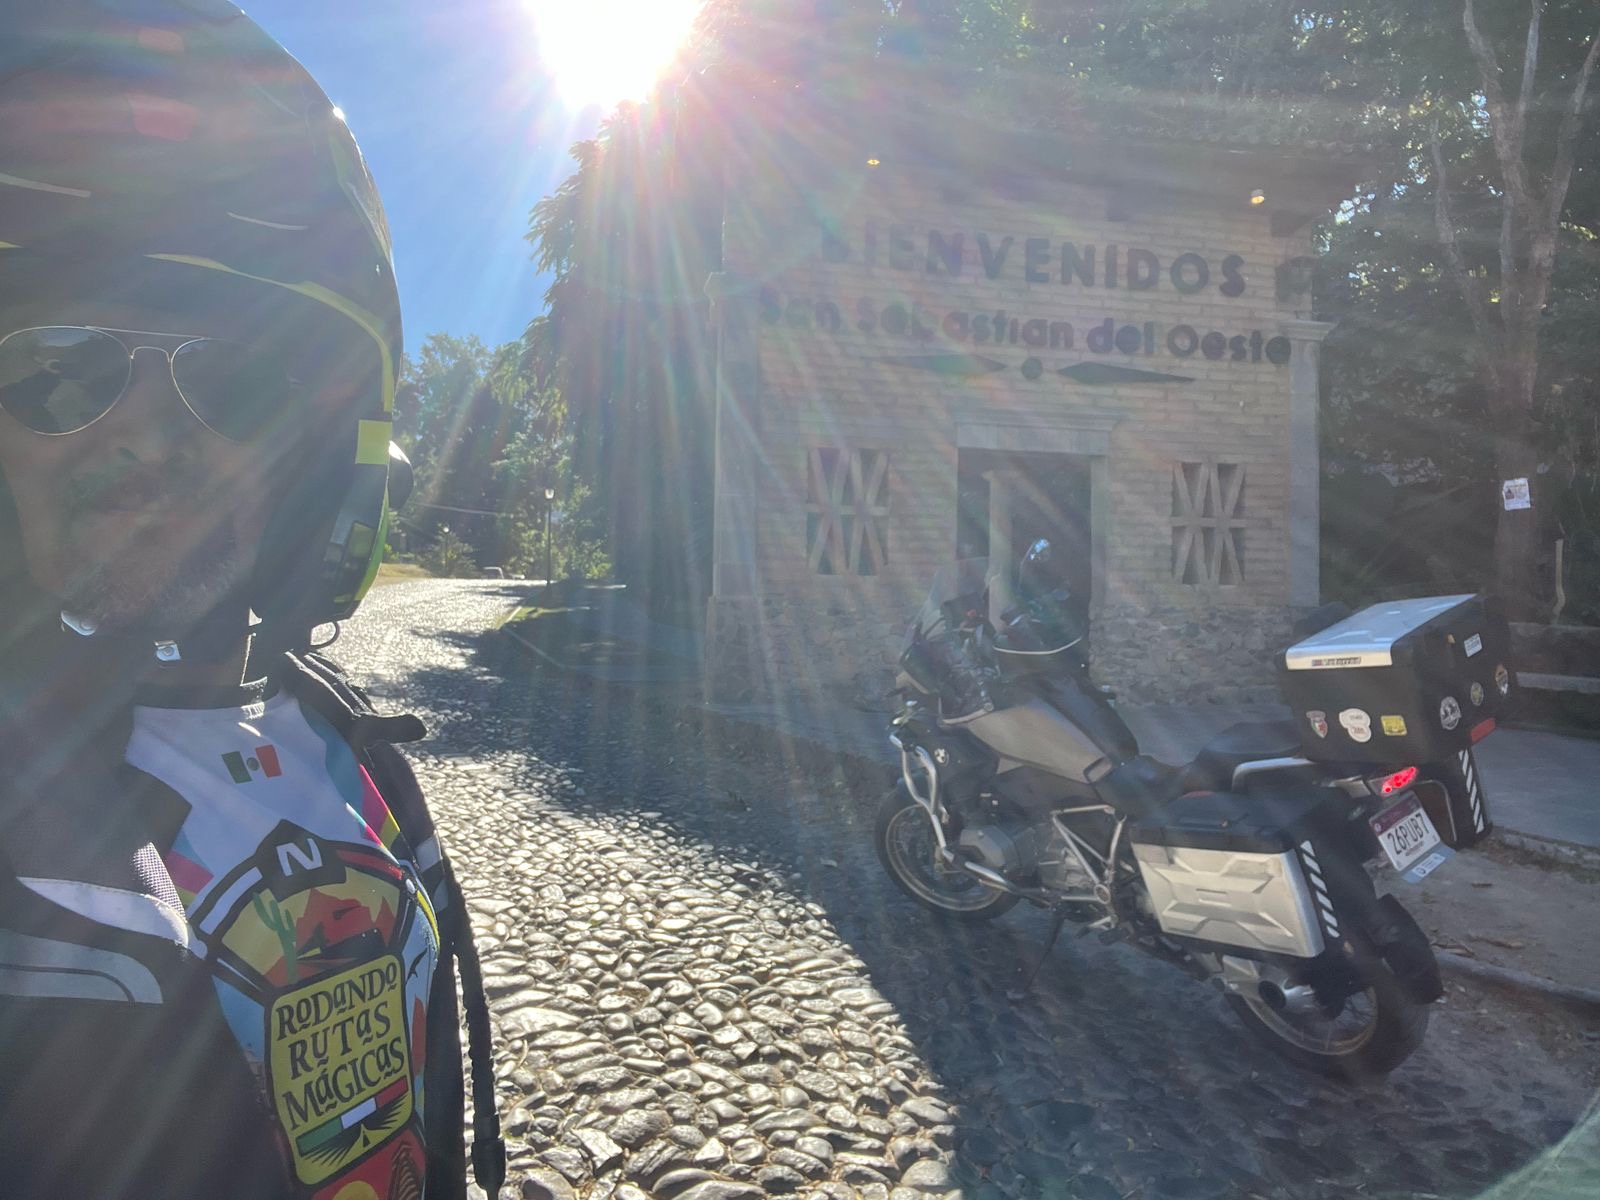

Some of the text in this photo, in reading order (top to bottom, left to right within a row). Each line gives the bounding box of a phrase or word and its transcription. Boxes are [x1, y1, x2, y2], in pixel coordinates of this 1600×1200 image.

[1086, 317, 1156, 356] del
[1166, 324, 1292, 365] Oeste
[276, 838, 323, 877] N
